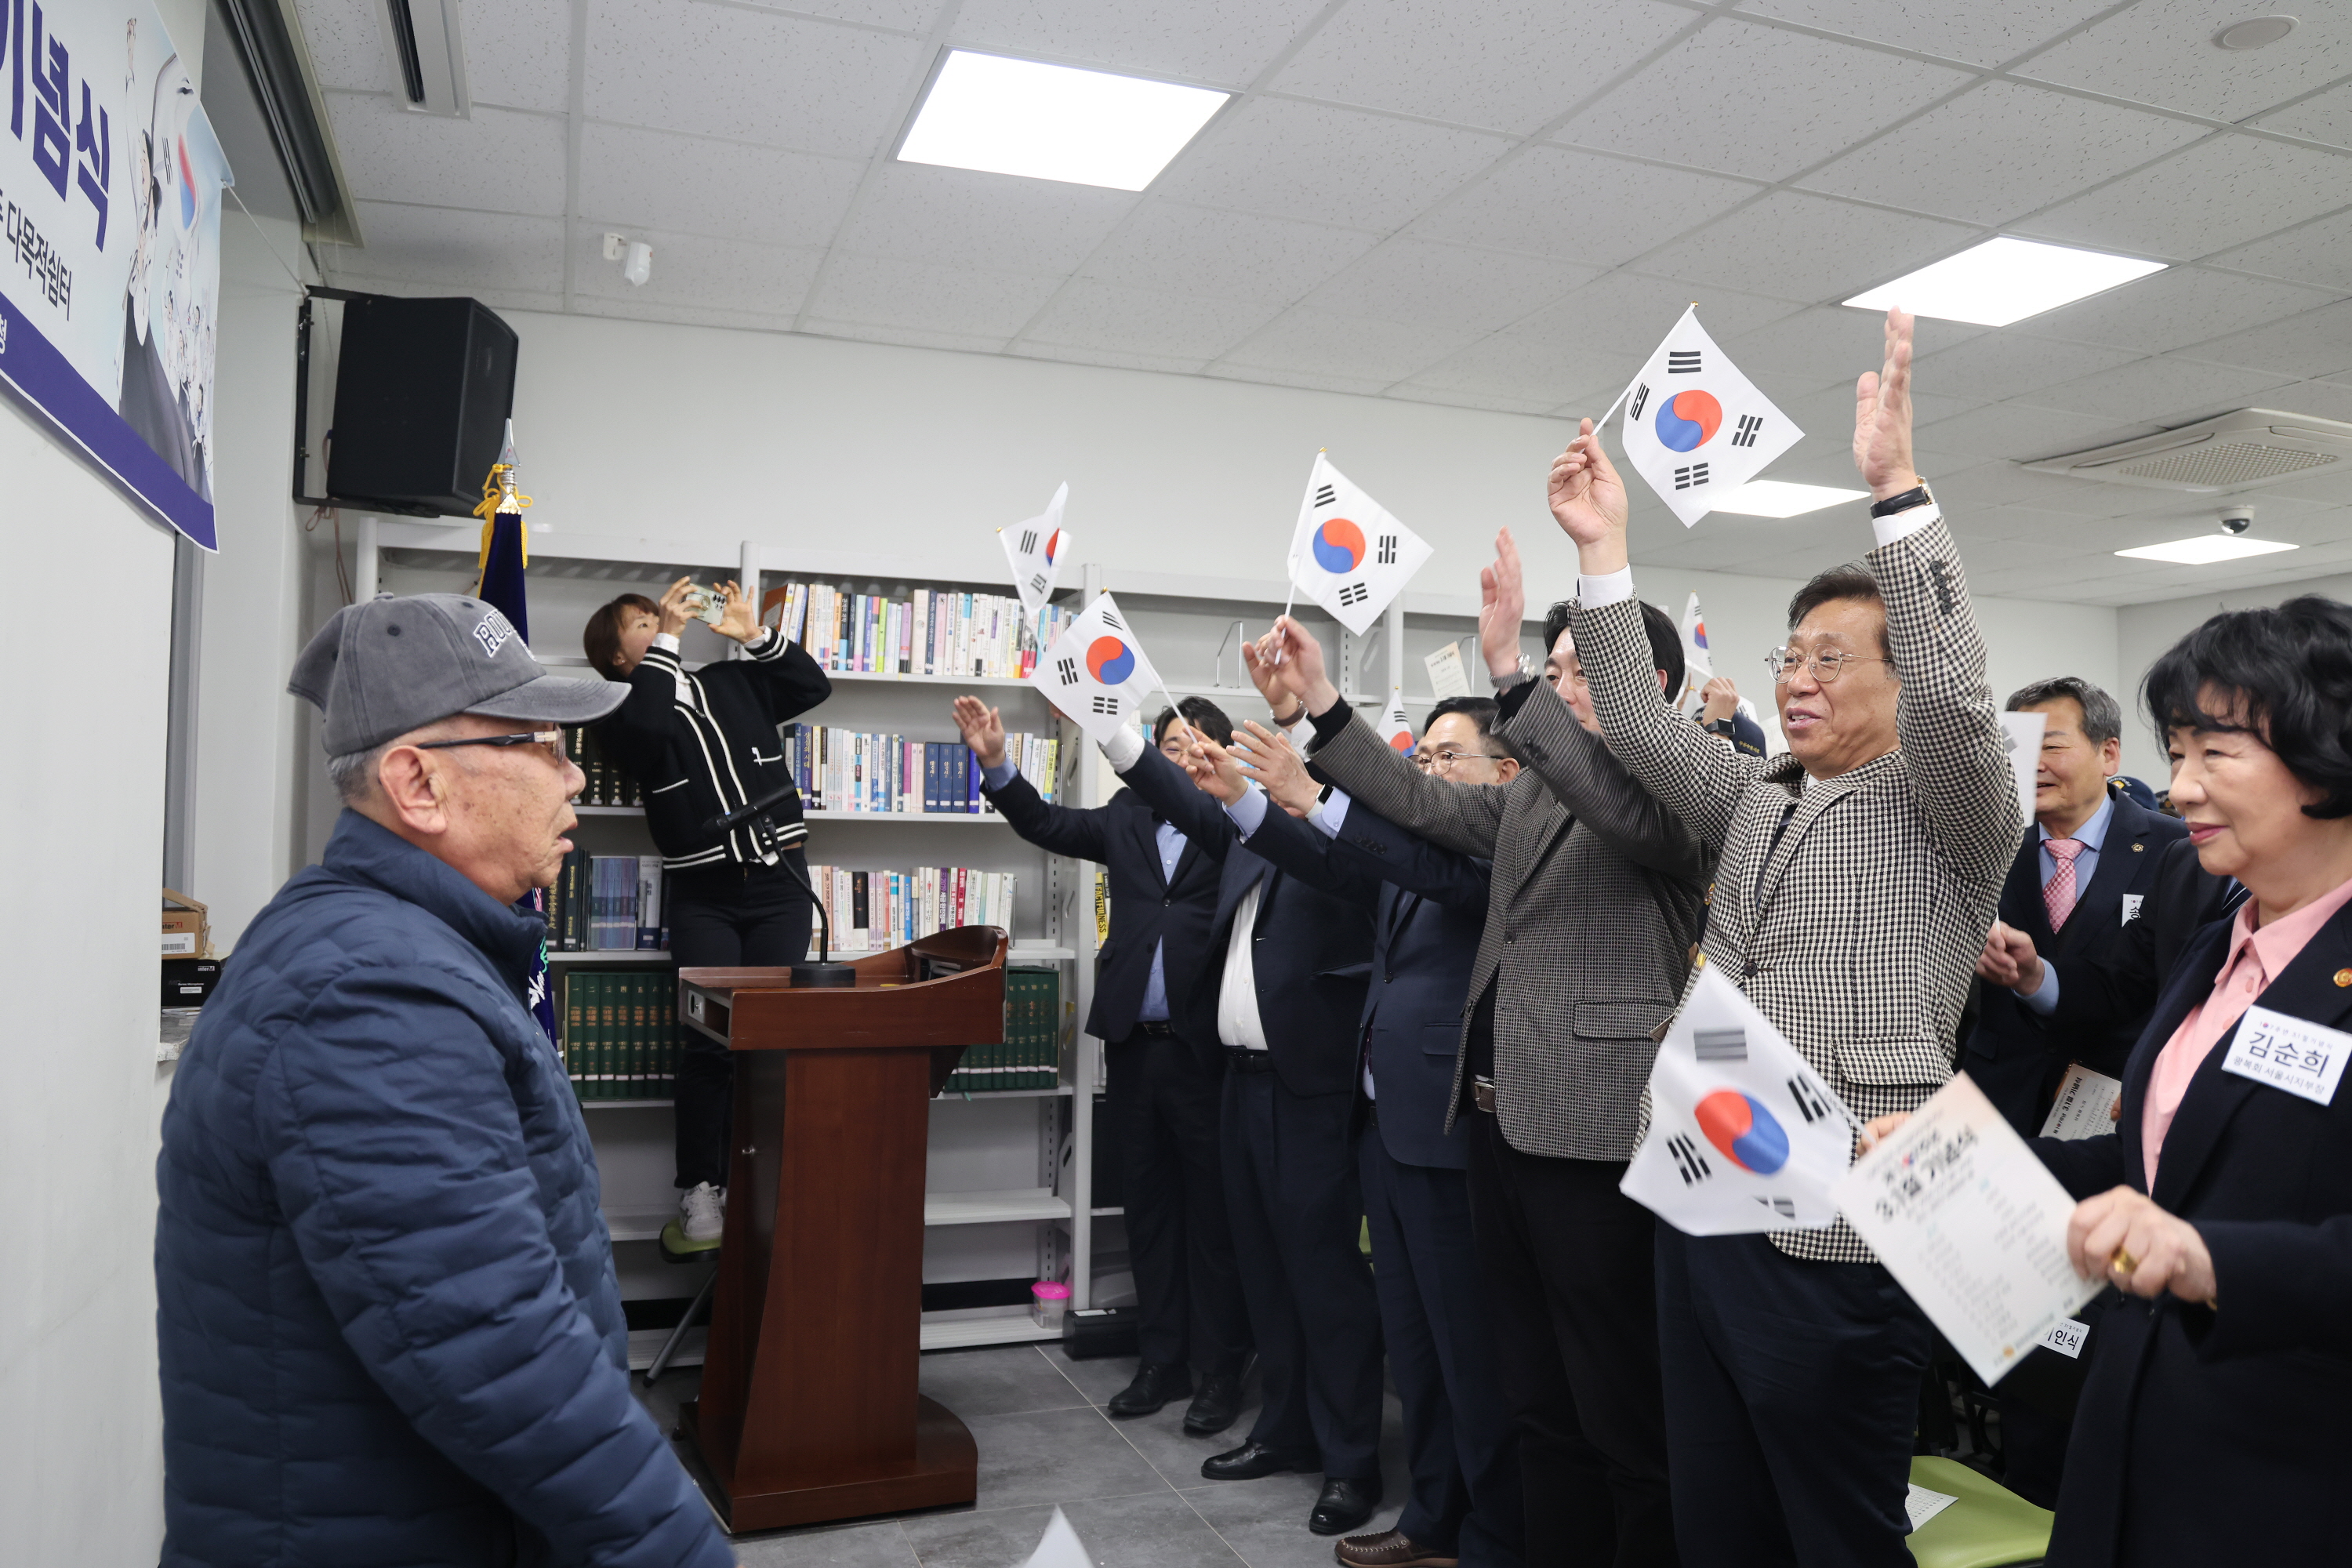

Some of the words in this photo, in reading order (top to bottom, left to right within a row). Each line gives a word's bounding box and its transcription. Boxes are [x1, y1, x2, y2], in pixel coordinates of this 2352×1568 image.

[6, 200, 72, 321] 다목적쉼터
[940, 891, 946, 902] 세금
[2234, 1056, 2263, 1074] 광복회
[2264, 1067, 2325, 1095] 서울시지부장
[2249, 1032, 2329, 1078] 김순희
